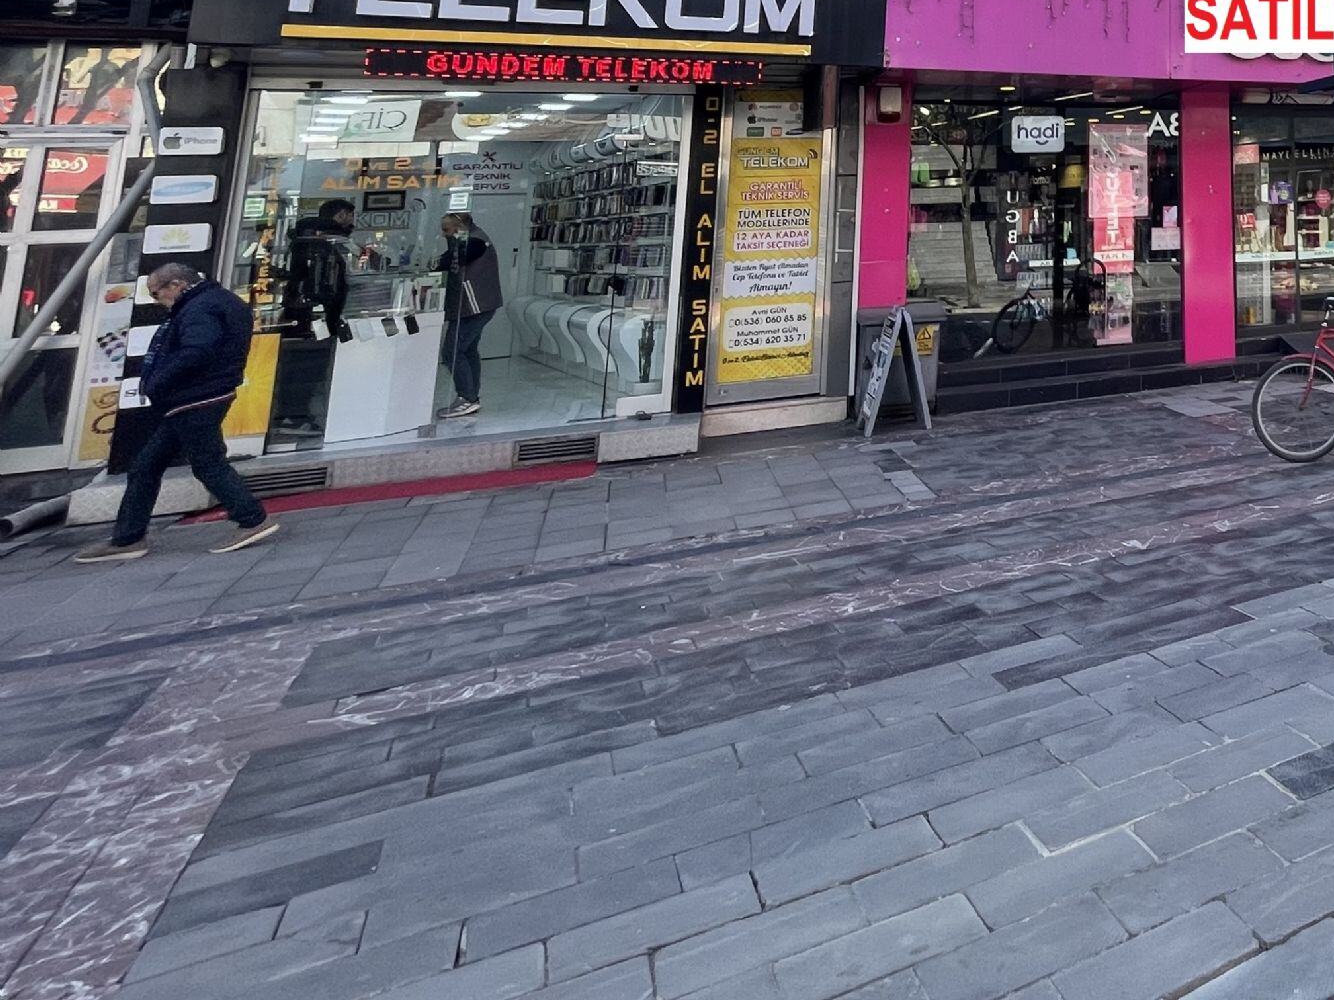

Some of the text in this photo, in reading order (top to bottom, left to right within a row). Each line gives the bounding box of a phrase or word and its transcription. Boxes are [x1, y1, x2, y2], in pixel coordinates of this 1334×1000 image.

[578, 57, 714, 82] TELEKOM
[1017, 124, 1059, 139] hadi
[183, 135, 218, 147] iPhone
[743, 156, 810, 169] TELEKOM
[321, 175, 381, 191] ALIM
[699, 162, 715, 195] EL
[749, 179, 803, 191] GARANTİLİ
[742, 189, 809, 201] TEKNİK SERVİS
[738, 208, 811, 219] TÜM TELEFON
[737, 218, 810, 228] MODELLERİNDE
[736, 230, 810, 241] 12 AYA KADAR
[692, 212, 713, 281] ALIM
[736, 238, 810, 251] TAKSİT SEÇENEĞİ
[732, 273, 746, 283] Cep
[769, 306, 787, 314] GÜN
[765, 315, 782, 324] 060
[781, 326, 799, 334] GÜN
[685, 299, 707, 388] SATIM
[765, 336, 781, 344] 620
[783, 334, 794, 343] 35
[796, 333, 806, 342] 71
